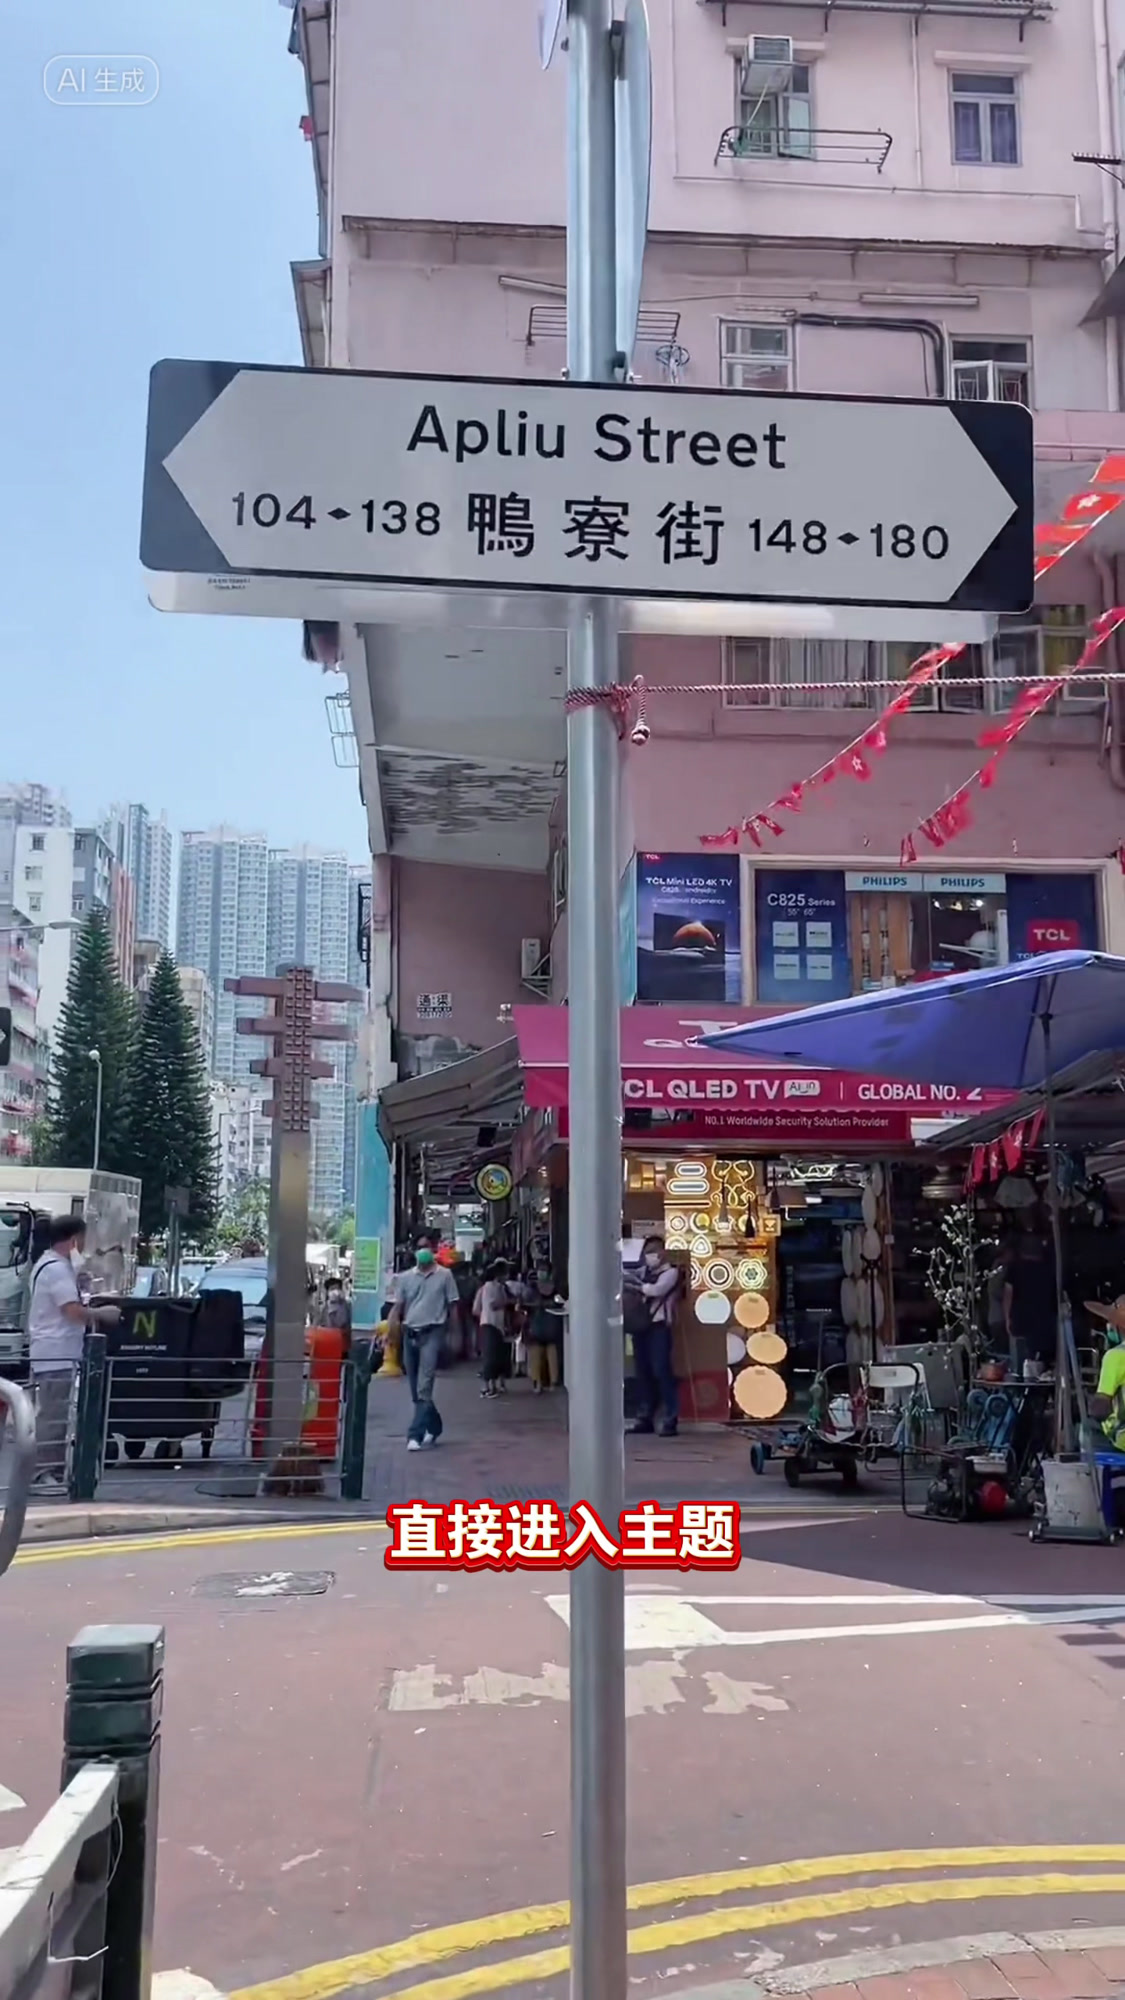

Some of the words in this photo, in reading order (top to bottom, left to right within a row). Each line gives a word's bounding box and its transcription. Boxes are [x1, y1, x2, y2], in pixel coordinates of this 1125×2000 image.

[406, 404, 566, 463] Apliu
[593, 413, 787, 469] Street
[231, 491, 317, 529] 104
[361, 499, 441, 536] 138
[467, 491, 725, 566] 鴨寮街
[748, 518, 828, 554] 148
[869, 523, 950, 560] 180
[645, 876, 666, 885] TCL
[666, 876, 685, 886] Mini
[686, 877, 705, 886] LED
[705, 878, 718, 887] 4K
[719, 878, 733, 887] TV
[862, 876, 908, 887] PHILIPS
[940, 877, 986, 888] PHILIPS
[767, 893, 806, 907] C825
[807, 897, 836, 907] Series
[1033, 928, 1071, 941] TCL
[622, 1079, 663, 1098] CL
[667, 1079, 738, 1099] QLED
[743, 1079, 781, 1099] TV
[858, 1083, 926, 1100] GLOBAL
[931, 1084, 961, 1100] NO.
[726, 1115, 774, 1126] Worldwide
[775, 1116, 812, 1128] Security
[813, 1116, 851, 1127] Solution
[852, 1116, 889, 1127] Provider
